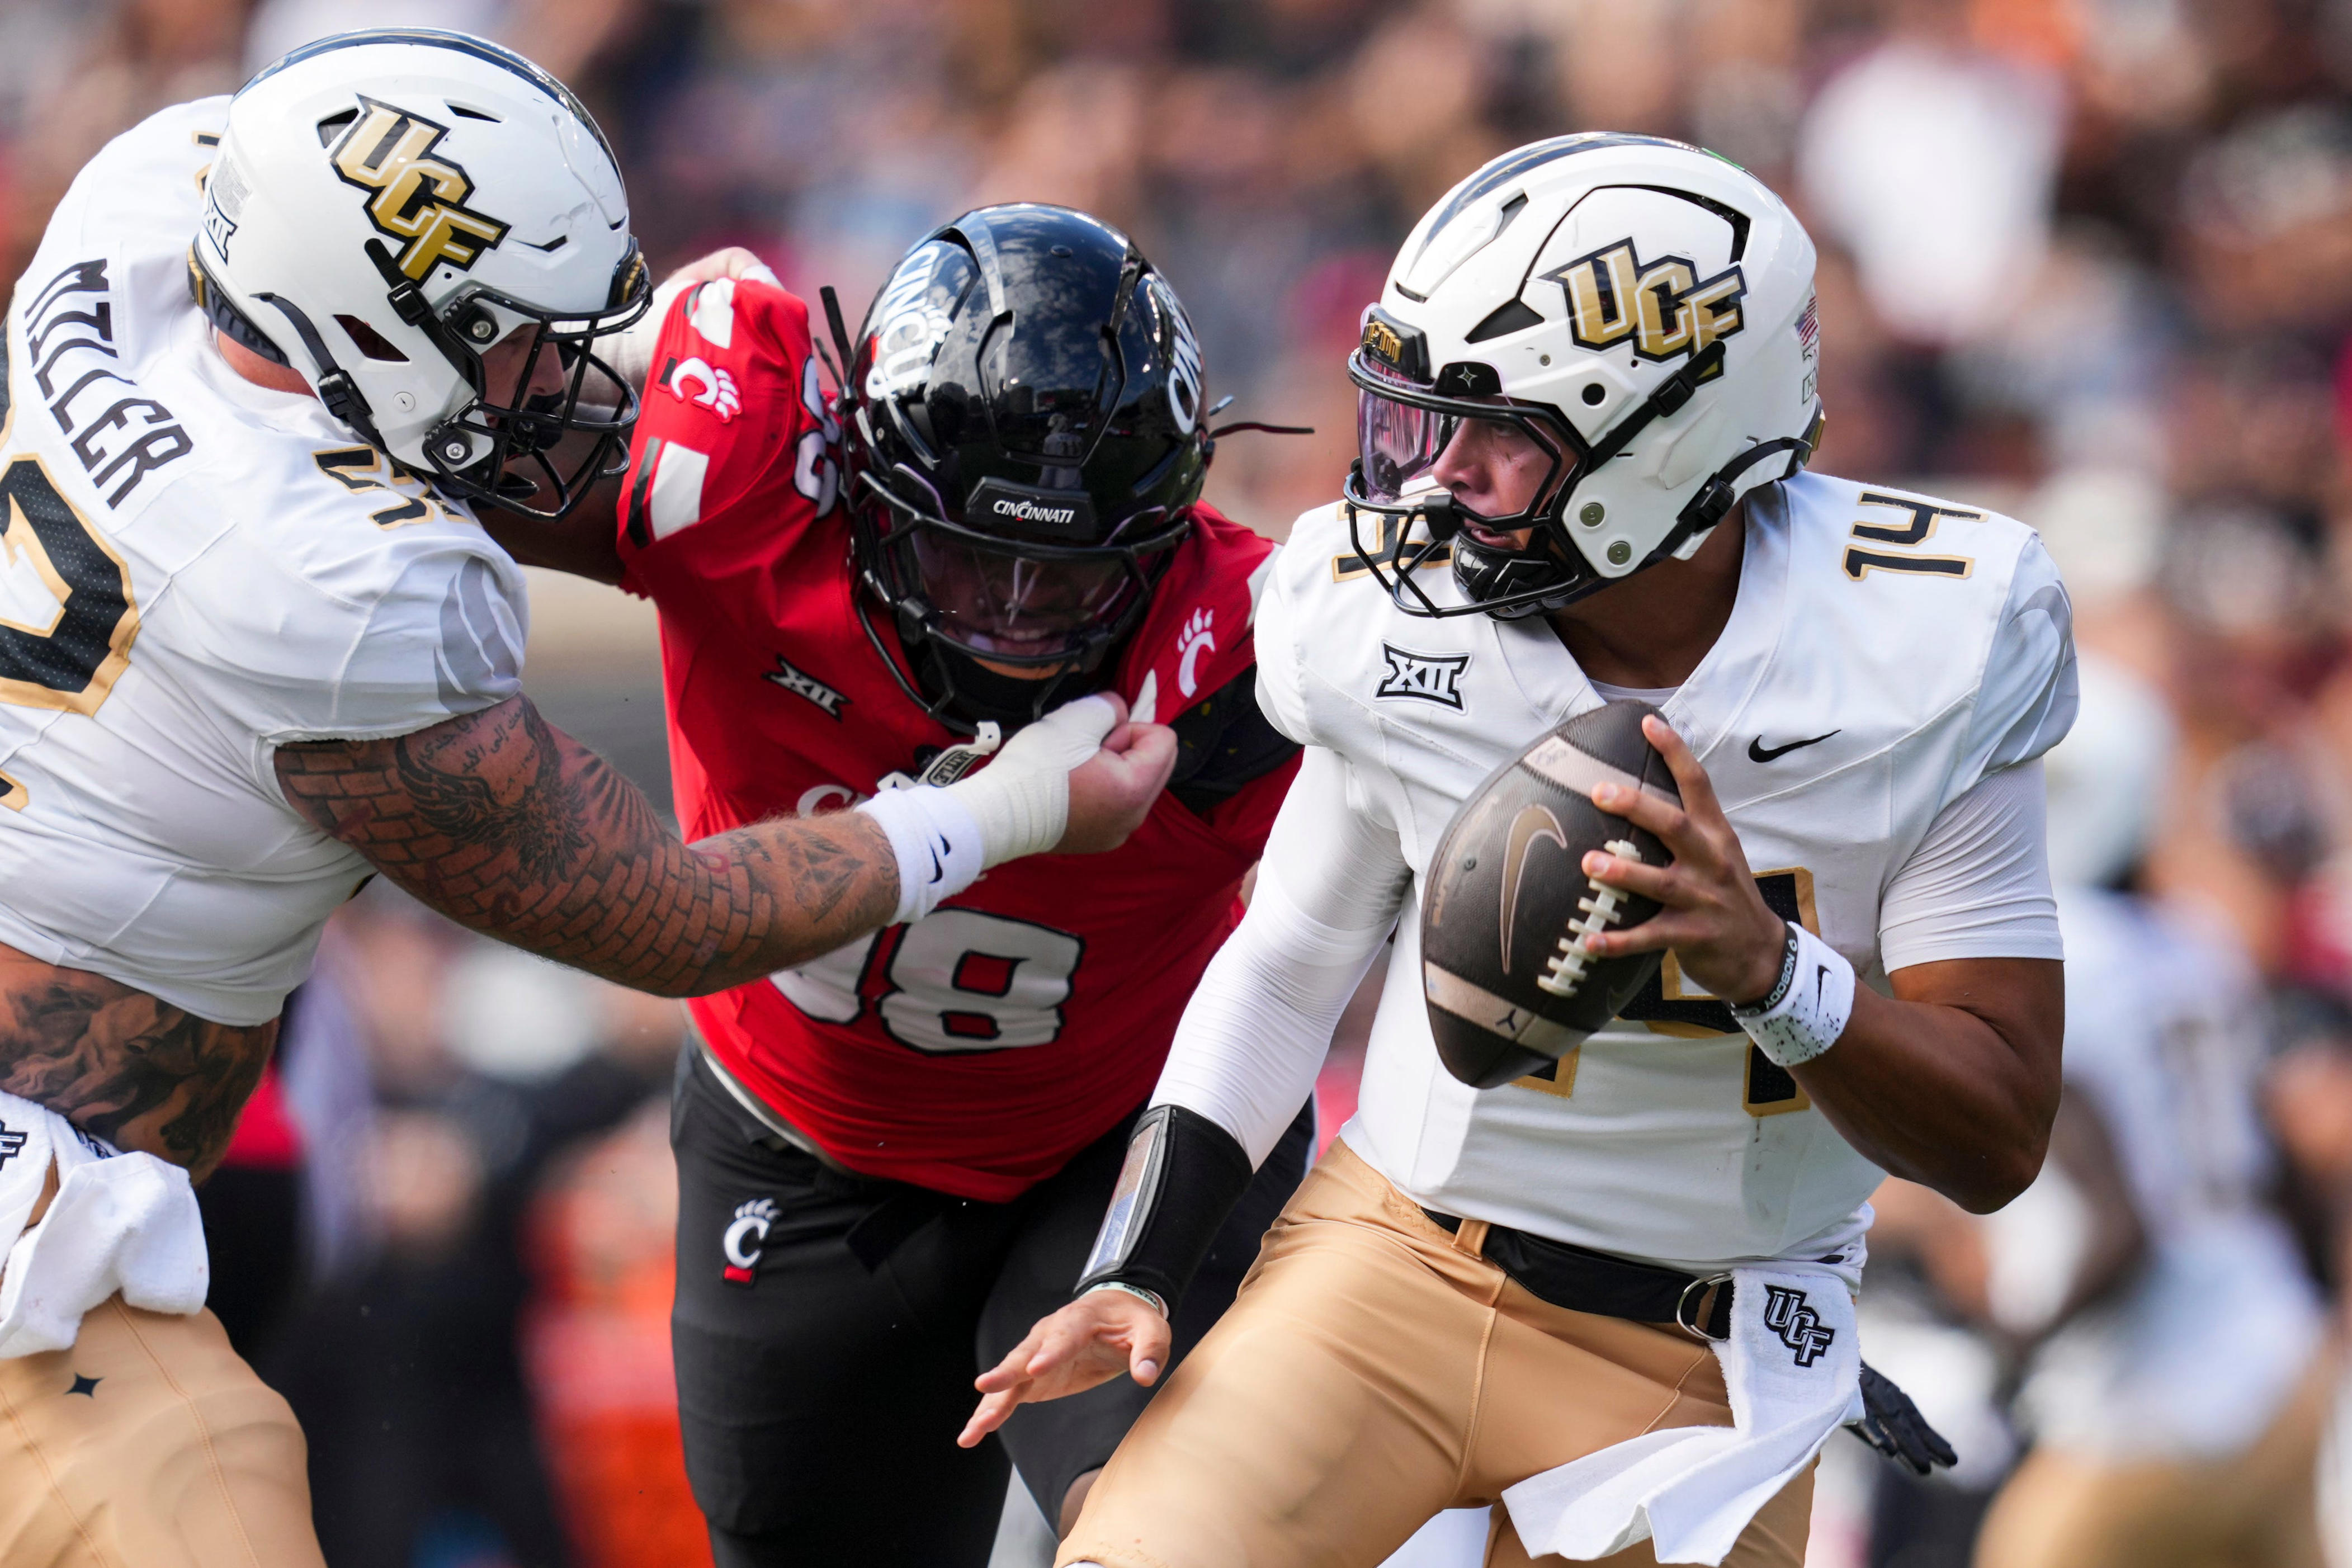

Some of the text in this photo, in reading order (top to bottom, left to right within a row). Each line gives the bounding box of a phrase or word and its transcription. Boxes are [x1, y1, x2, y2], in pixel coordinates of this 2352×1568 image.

[331, 93, 512, 289] UCF
[1539, 237, 1747, 381] UCF
[25, 258, 193, 510] MILLER
[993, 500, 1075, 523] CINCINNATI
[1842, 490, 1990, 582] 14
[762, 654, 852, 722] XII
[1376, 643, 1470, 710] XII
[1764, 952, 1796, 1010] NOBODY
[1764, 1284, 1835, 1367] UCF
